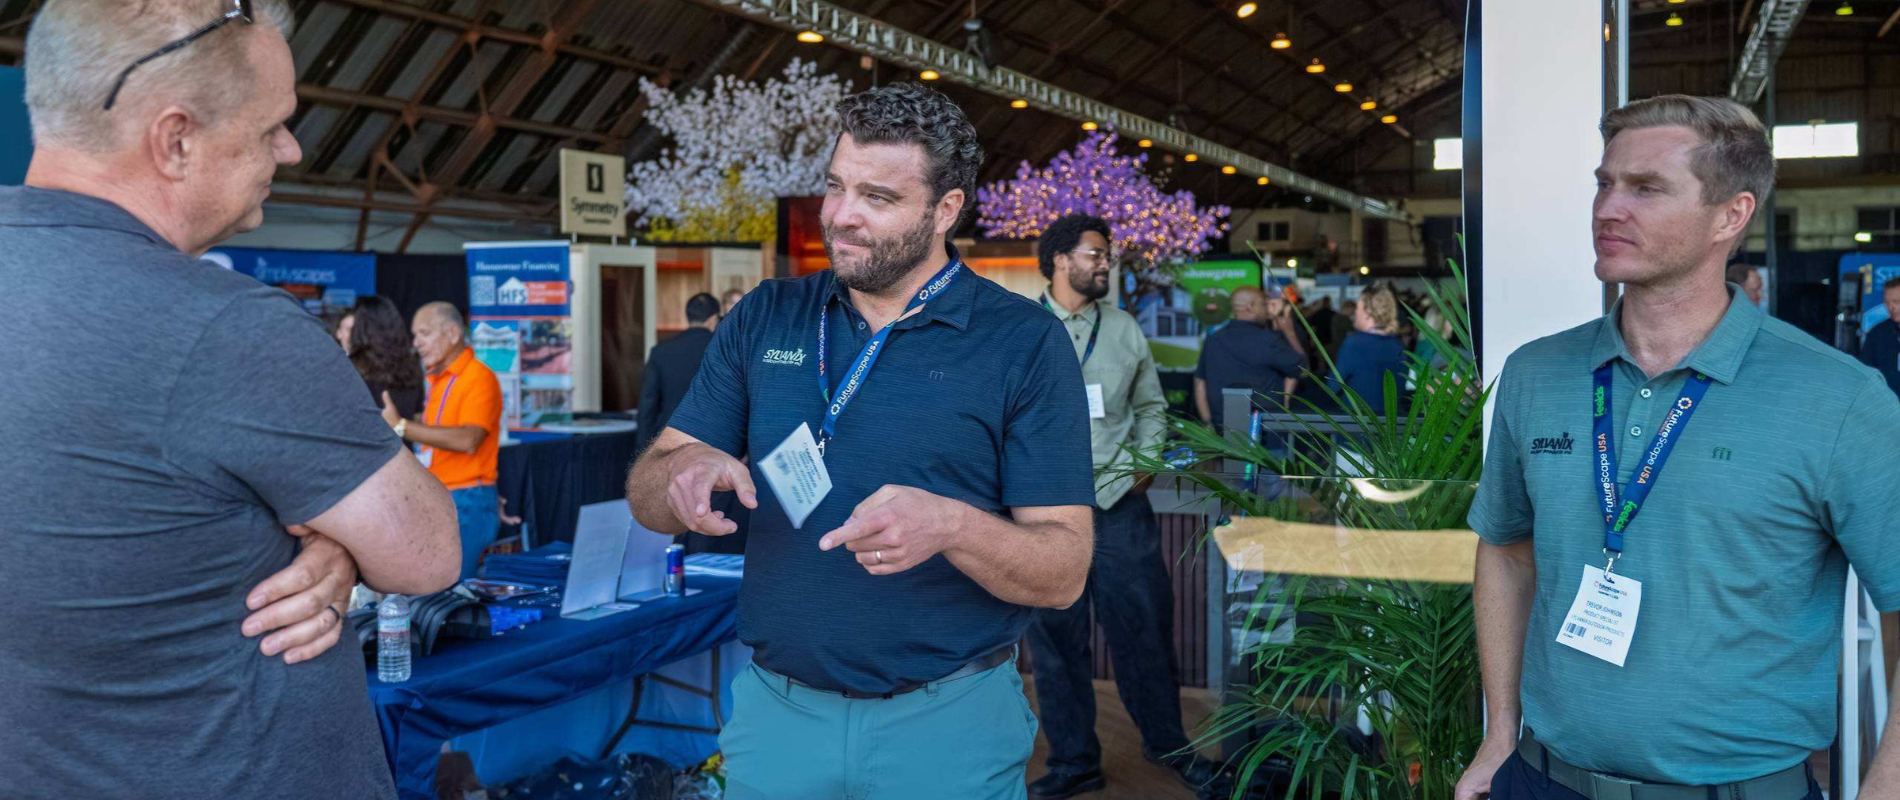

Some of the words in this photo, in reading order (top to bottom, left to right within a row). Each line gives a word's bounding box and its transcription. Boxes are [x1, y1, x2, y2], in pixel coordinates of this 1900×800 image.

[570, 196, 618, 218] Symmetry
[522, 260, 560, 273] Financing
[500, 289, 526, 304] HFS
[763, 348, 807, 362] SYLVANIX
[837, 355, 870, 404] FutureScape
[866, 340, 880, 356] USA
[1531, 436, 1575, 450] SYLVANIX
[1597, 433, 1607, 453] USA
[1647, 409, 1683, 466] FutureScape
[1600, 453, 1614, 513] FutureScape
[1636, 465, 1653, 485] USA
[1586, 600, 1603, 611] TREVOR
[1602, 606, 1623, 618] JOHNSON
[1593, 634, 1613, 646] VISITOR
